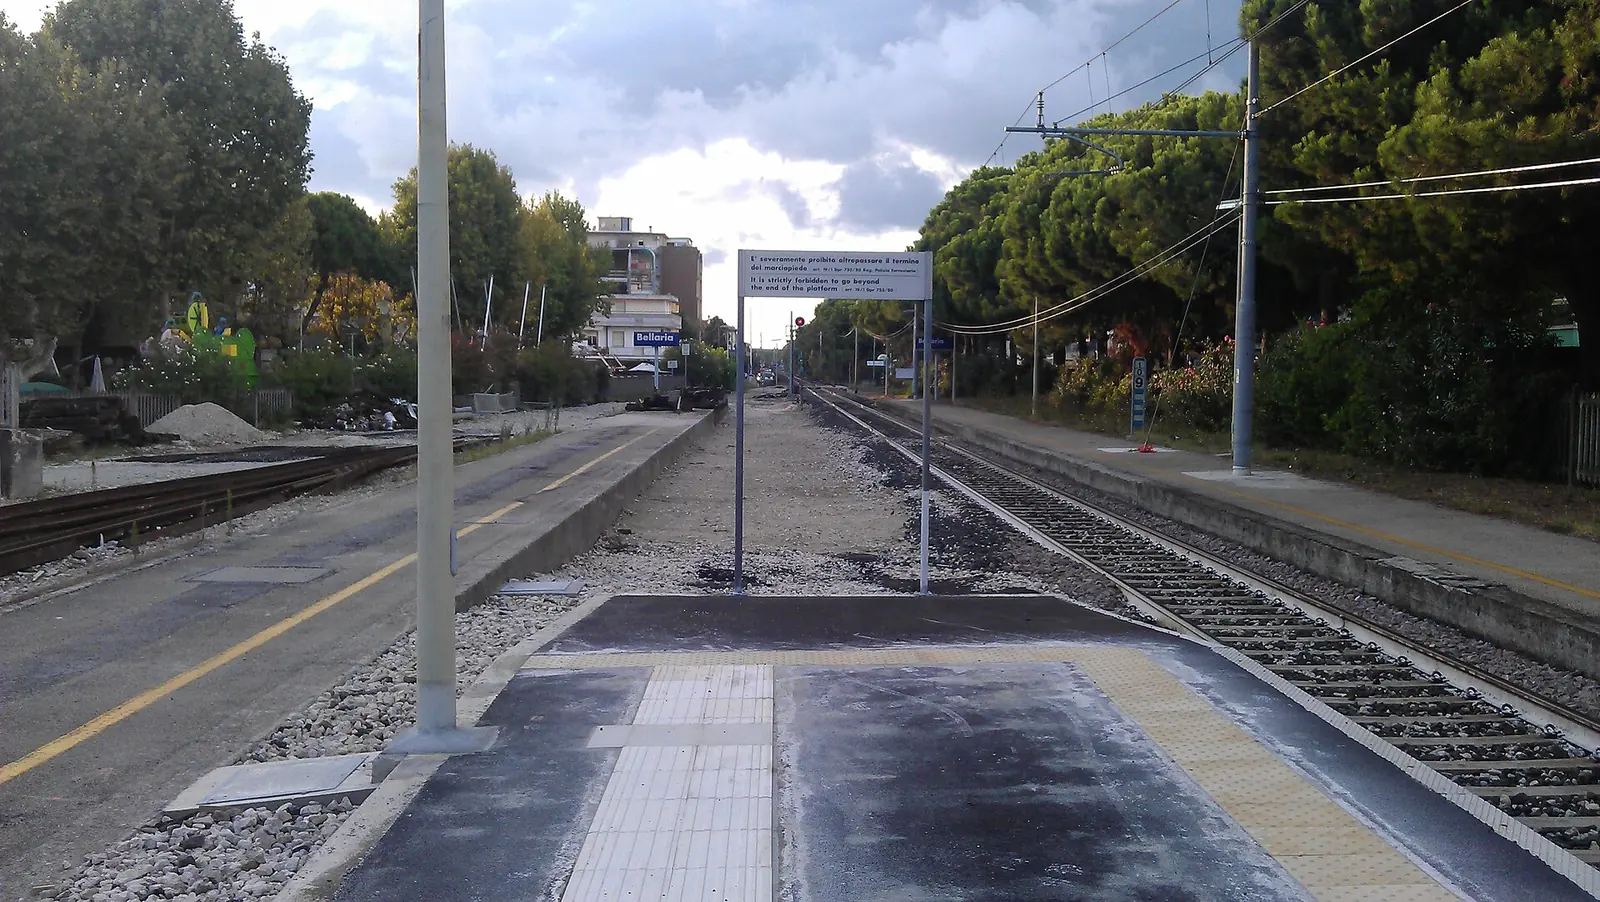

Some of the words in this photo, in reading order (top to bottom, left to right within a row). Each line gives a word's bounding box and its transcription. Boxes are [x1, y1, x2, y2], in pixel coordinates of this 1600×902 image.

[853, 278, 880, 286] beyond
[806, 285, 838, 293] platform
[636, 332, 674, 342] Bellaria
